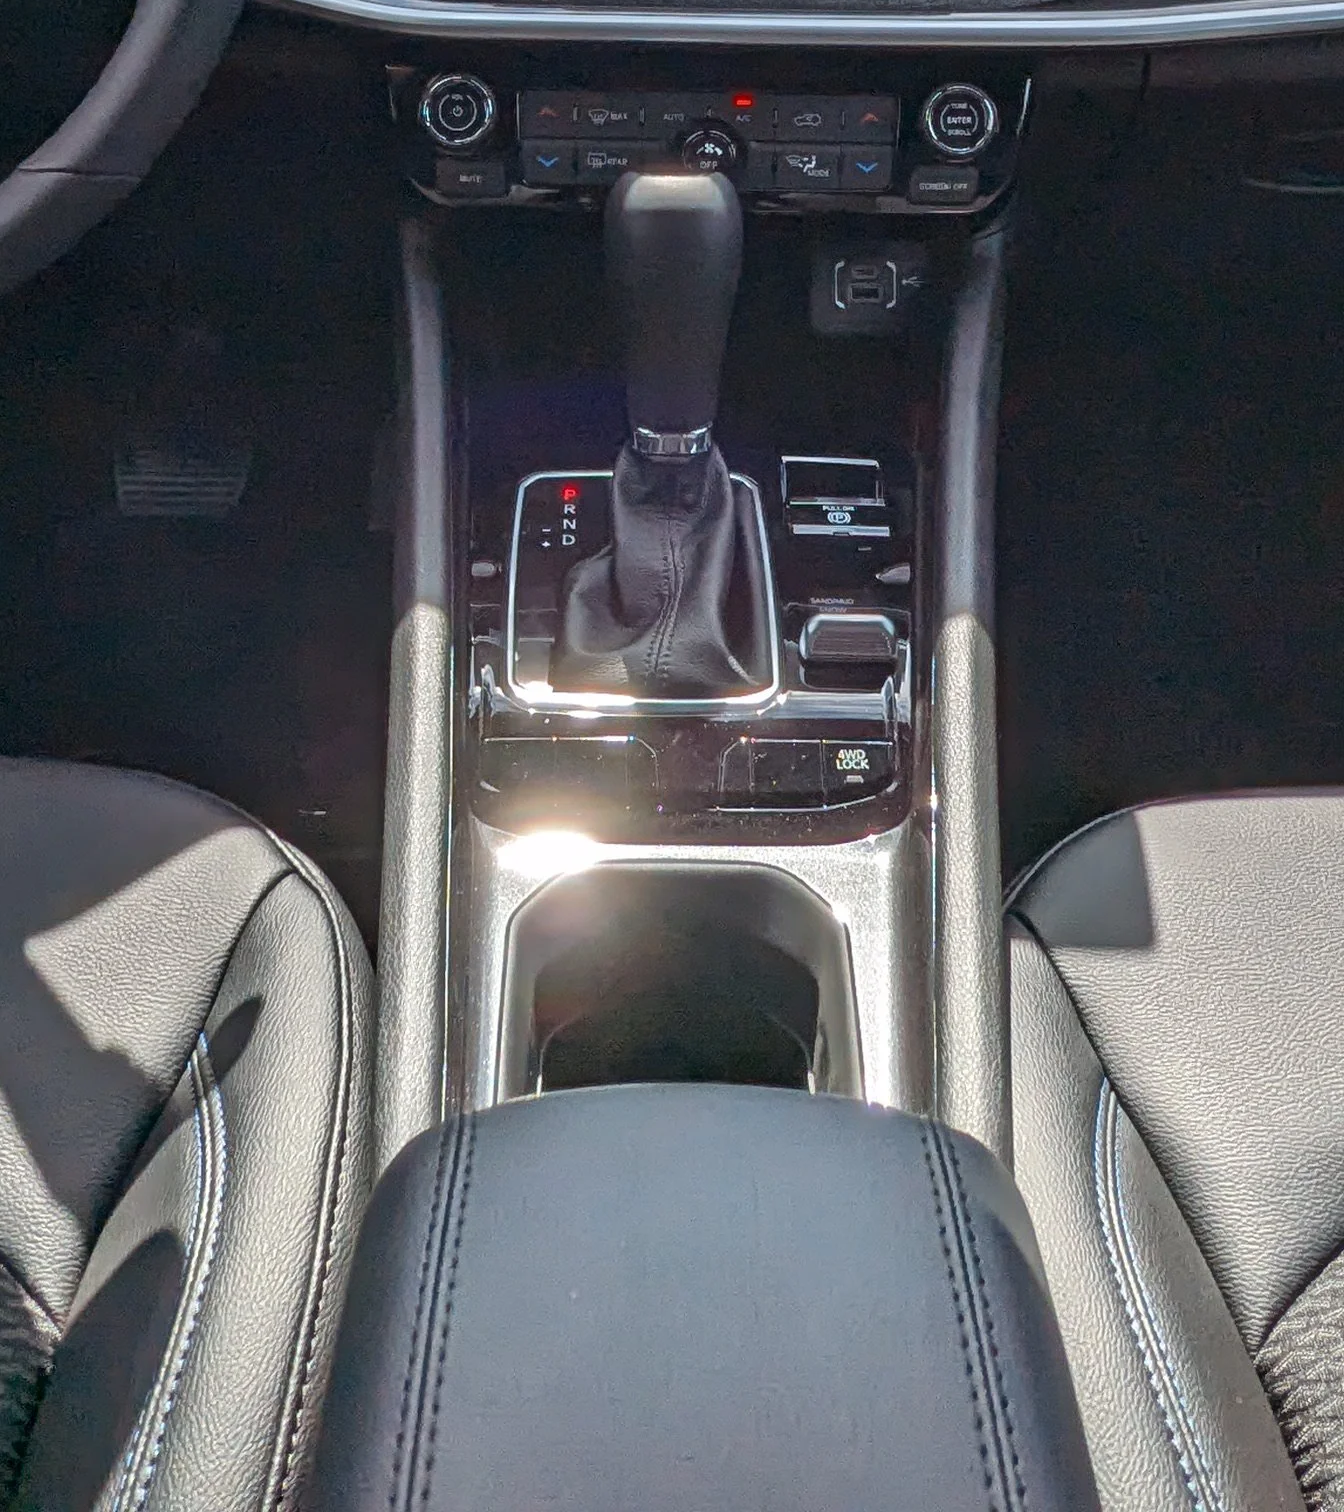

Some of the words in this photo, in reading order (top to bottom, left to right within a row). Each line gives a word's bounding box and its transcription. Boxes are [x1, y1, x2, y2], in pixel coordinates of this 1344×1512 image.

[946, 116, 972, 125] ENTER
[563, 488, 576, 501] P
[564, 503, 576, 515] R
[563, 518, 576, 530] N
[562, 534, 576, 546] D
[838, 749, 866, 759] 4WD
[836, 758, 870, 770] LOCK
